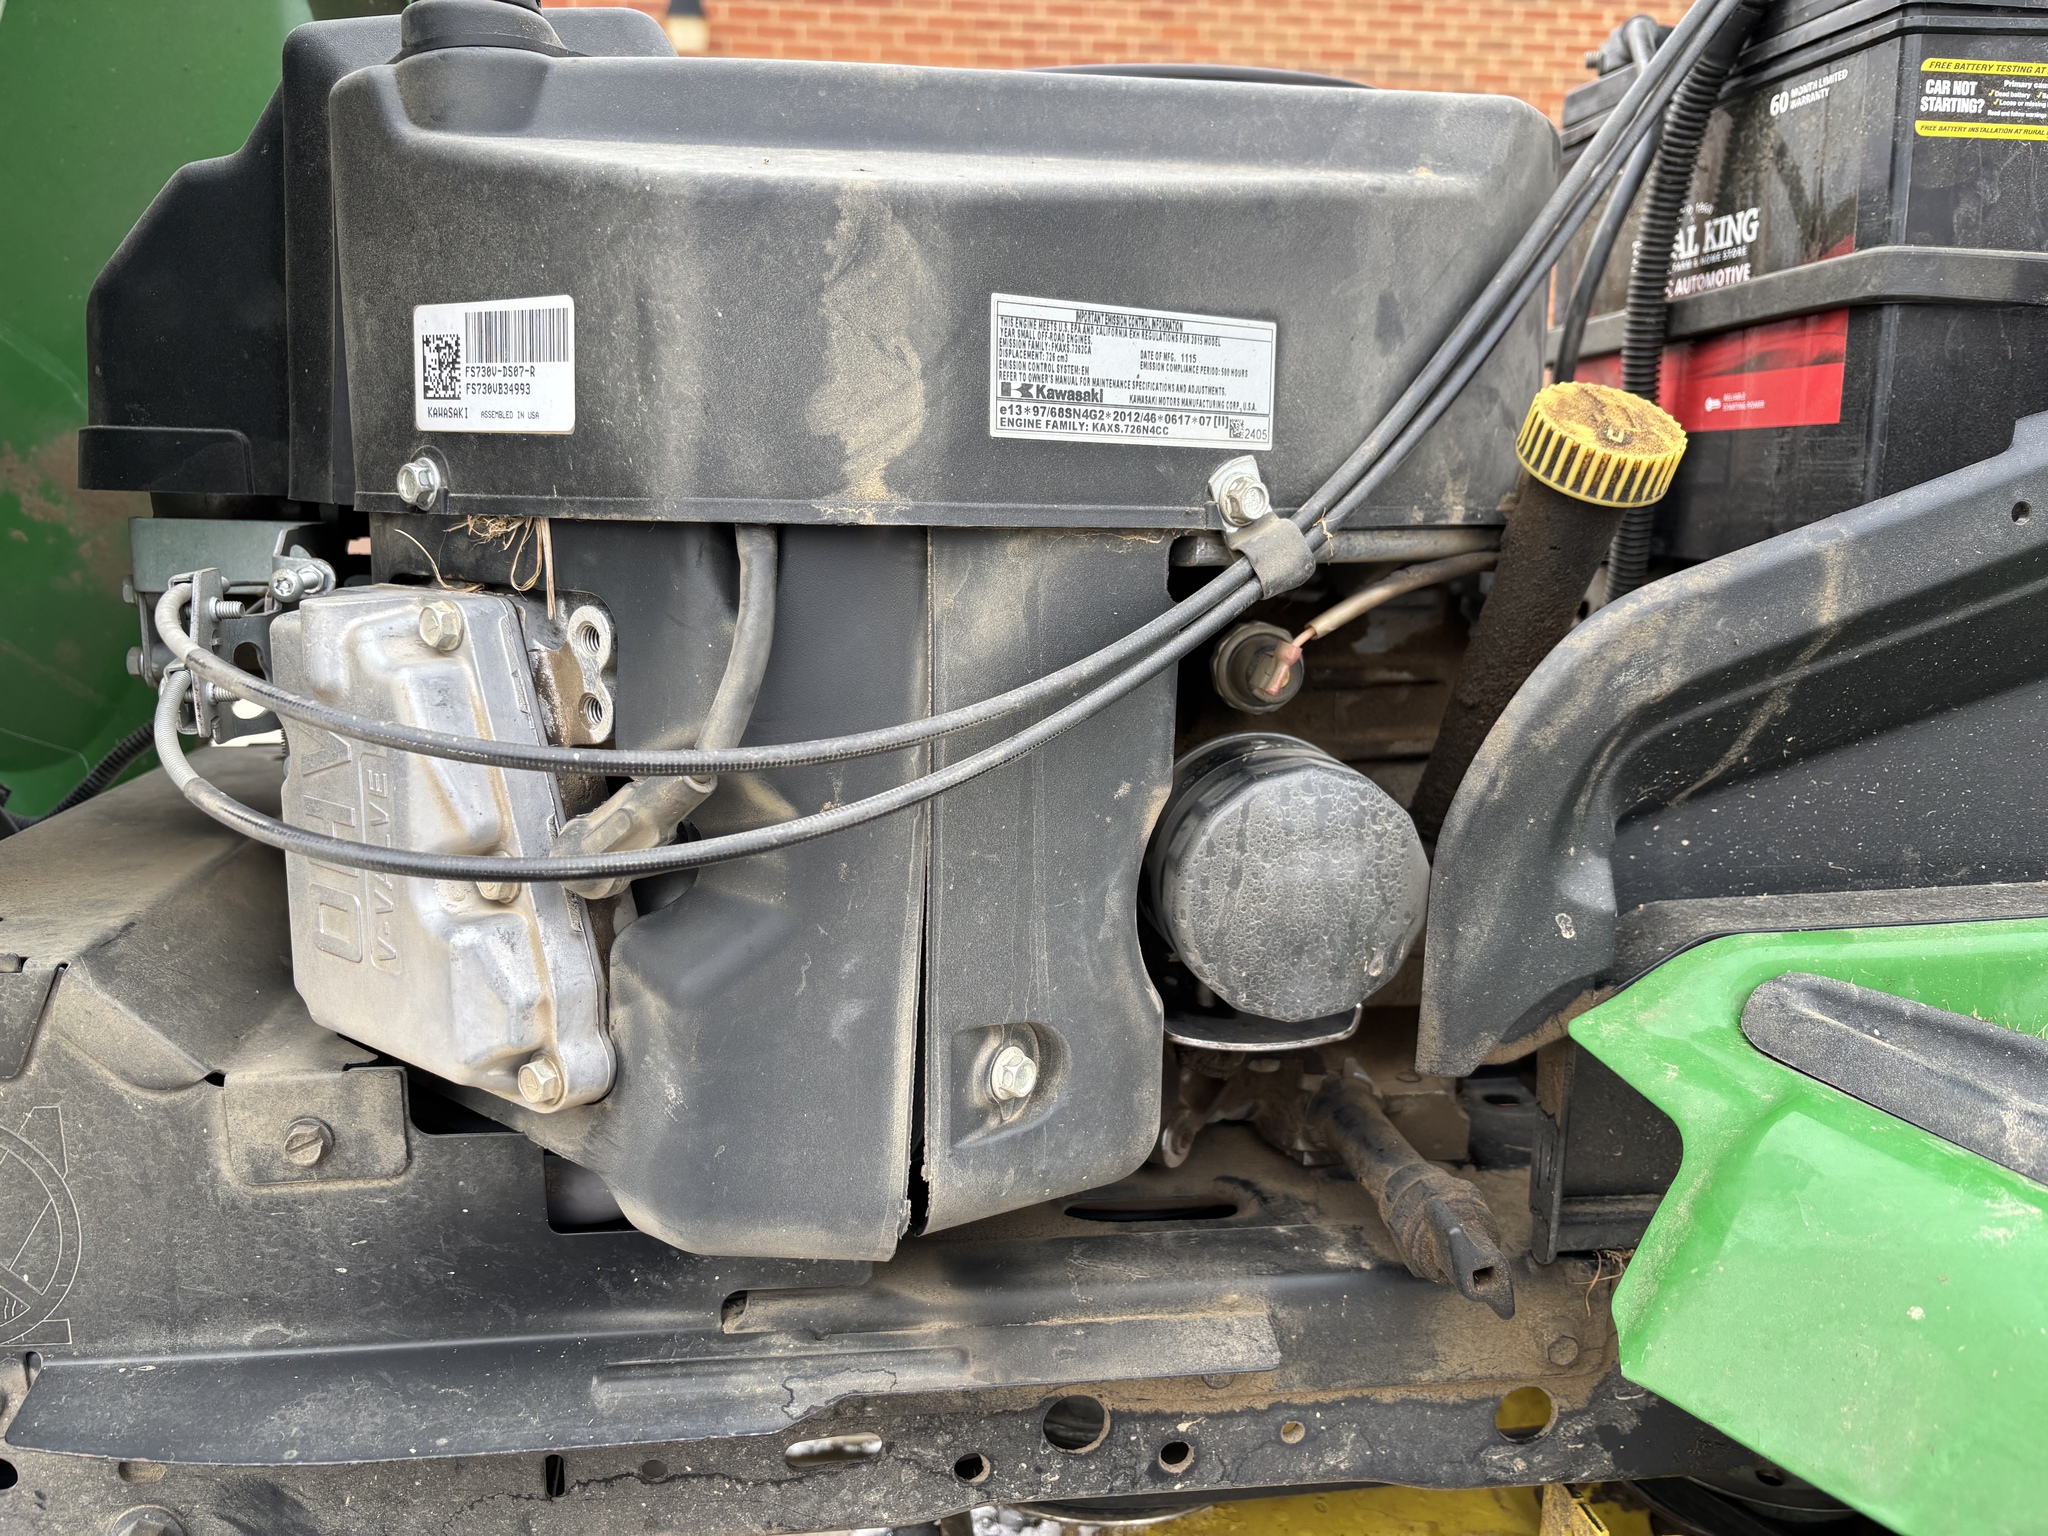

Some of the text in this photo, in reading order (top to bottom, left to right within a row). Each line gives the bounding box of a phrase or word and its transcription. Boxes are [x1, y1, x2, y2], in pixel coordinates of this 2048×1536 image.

[1954, 63, 1994, 71] BATTERY
[1996, 65, 2033, 73] TESTING
[1791, 68, 1848, 98] MONTH LIMITED
[1926, 79, 1978, 96] CAR NOT
[2004, 80, 2033, 89] Primary
[1770, 91, 1789, 117] 60
[1790, 88, 1830, 110] WARRANTY
[1920, 96, 1985, 113] STARTING?
[1703, 207, 1760, 254] KING
[1722, 245, 1748, 260] STORE
[1674, 263, 1751, 296] AUTOMOTIVE
[1105, 313, 1127, 326] EMISSION
[1128, 316, 1150, 328] CONTROL
[1151, 318, 1183, 332] INFORMATION
[1000, 316, 1013, 327] THIS
[1015, 318, 1036, 330] ENGINE
[1038, 320, 1057, 331] MEETS
[1070, 323, 1081, 334] EPA
[1082, 324, 1094, 335] AND
[1095, 325, 1127, 338] CALIFORNIA
[1141, 330, 1178, 342] REGULATIONS
[1179, 333, 1189, 344] FOR
[1203, 336, 1220, 346] MODEL
[1000, 327, 1015, 338] YEAR
[1017, 328, 1035, 340] SMALL
[1037, 330, 1065, 342] OFF-ROAD
[999, 337, 1026, 349] EMISSION
[1045, 352, 1055, 361] 726
[1140, 349, 1153, 360] DATE
[1154, 351, 1161, 360] OF
[1180, 353, 1196, 363] 1115
[465, 366, 535, 378] FS730V-DS07-R
[998, 359, 1026, 370] EMISSION
[1027, 361, 1054, 372] CONTROL
[1081, 365, 1089, 375] EM
[1139, 360, 1164, 371] EMISSION
[1165, 363, 1198, 374] COMPLIANCE
[1230, 368, 1248, 378] HOURS
[466, 383, 530, 395] FS730VB34993
[998, 370, 1017, 381] REFER
[1018, 372, 1026, 382] TO
[1055, 374, 1078, 385] MANUAL
[1079, 376, 1090, 386] FOR
[1091, 377, 1130, 389] MAINTENANCE
[1131, 380, 1174, 392] SPECIFICATIONS
[1176, 383, 1186, 393] AND
[1036, 383, 1103, 402] Kawasaki
[1129, 394, 1157, 405] KAWASAKI
[1158, 396, 1180, 406] MOTORS
[1181, 397, 1224, 409] MANUFACTURING
[428, 407, 539, 419] KAWASAKI ASSEMBLED IN USA
[1000, 417, 1168, 435] ENGINE FAMILY: KAXS.726N4CC
[1244, 428, 1267, 440] 2405
